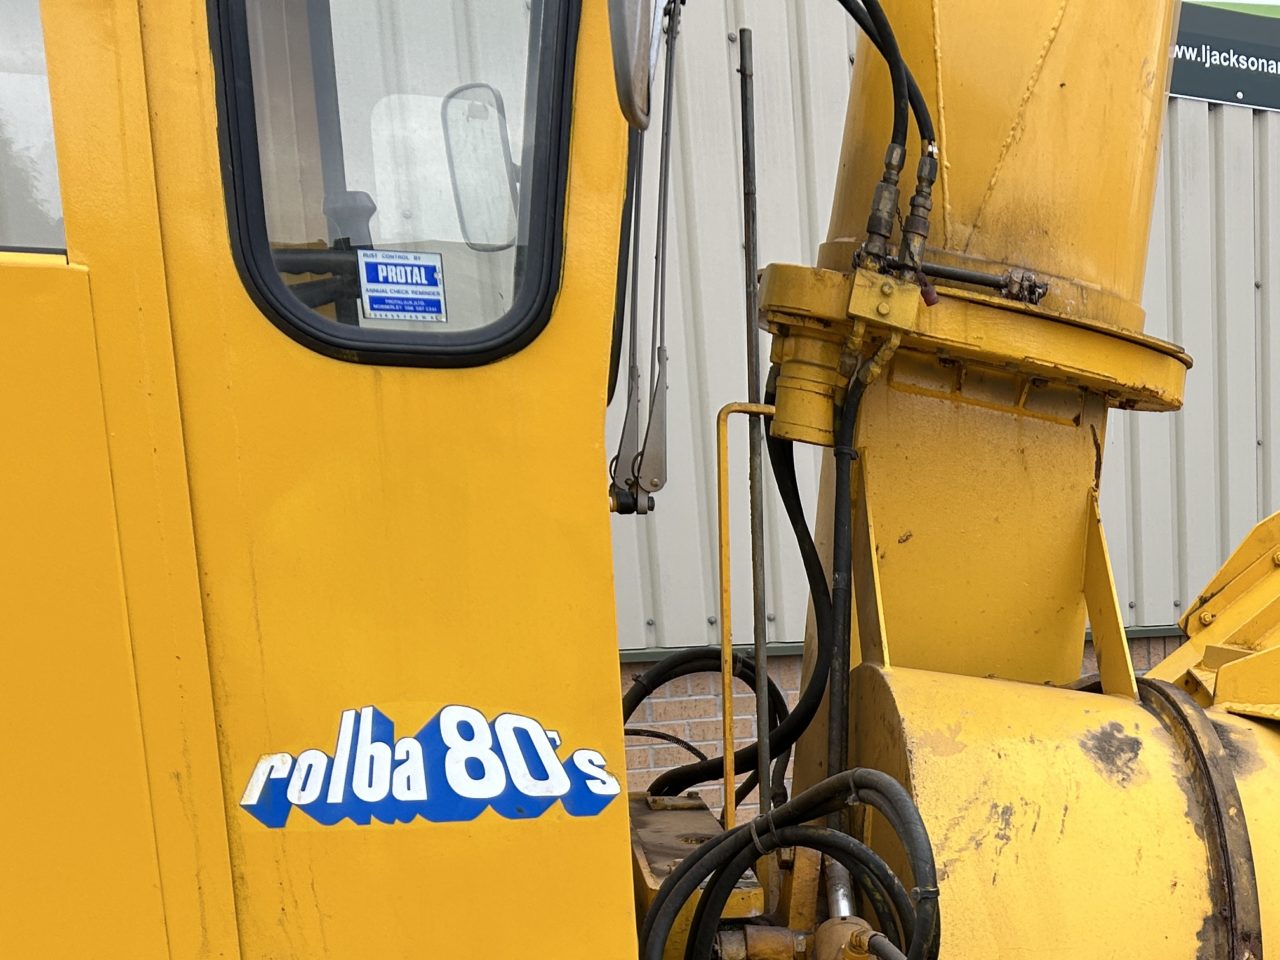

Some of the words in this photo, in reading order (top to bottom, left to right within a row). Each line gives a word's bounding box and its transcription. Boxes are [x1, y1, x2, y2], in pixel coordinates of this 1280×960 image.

[377, 263, 429, 285] PROTAL
[240, 704, 429, 812] rolba
[438, 704, 622, 804] 80's
